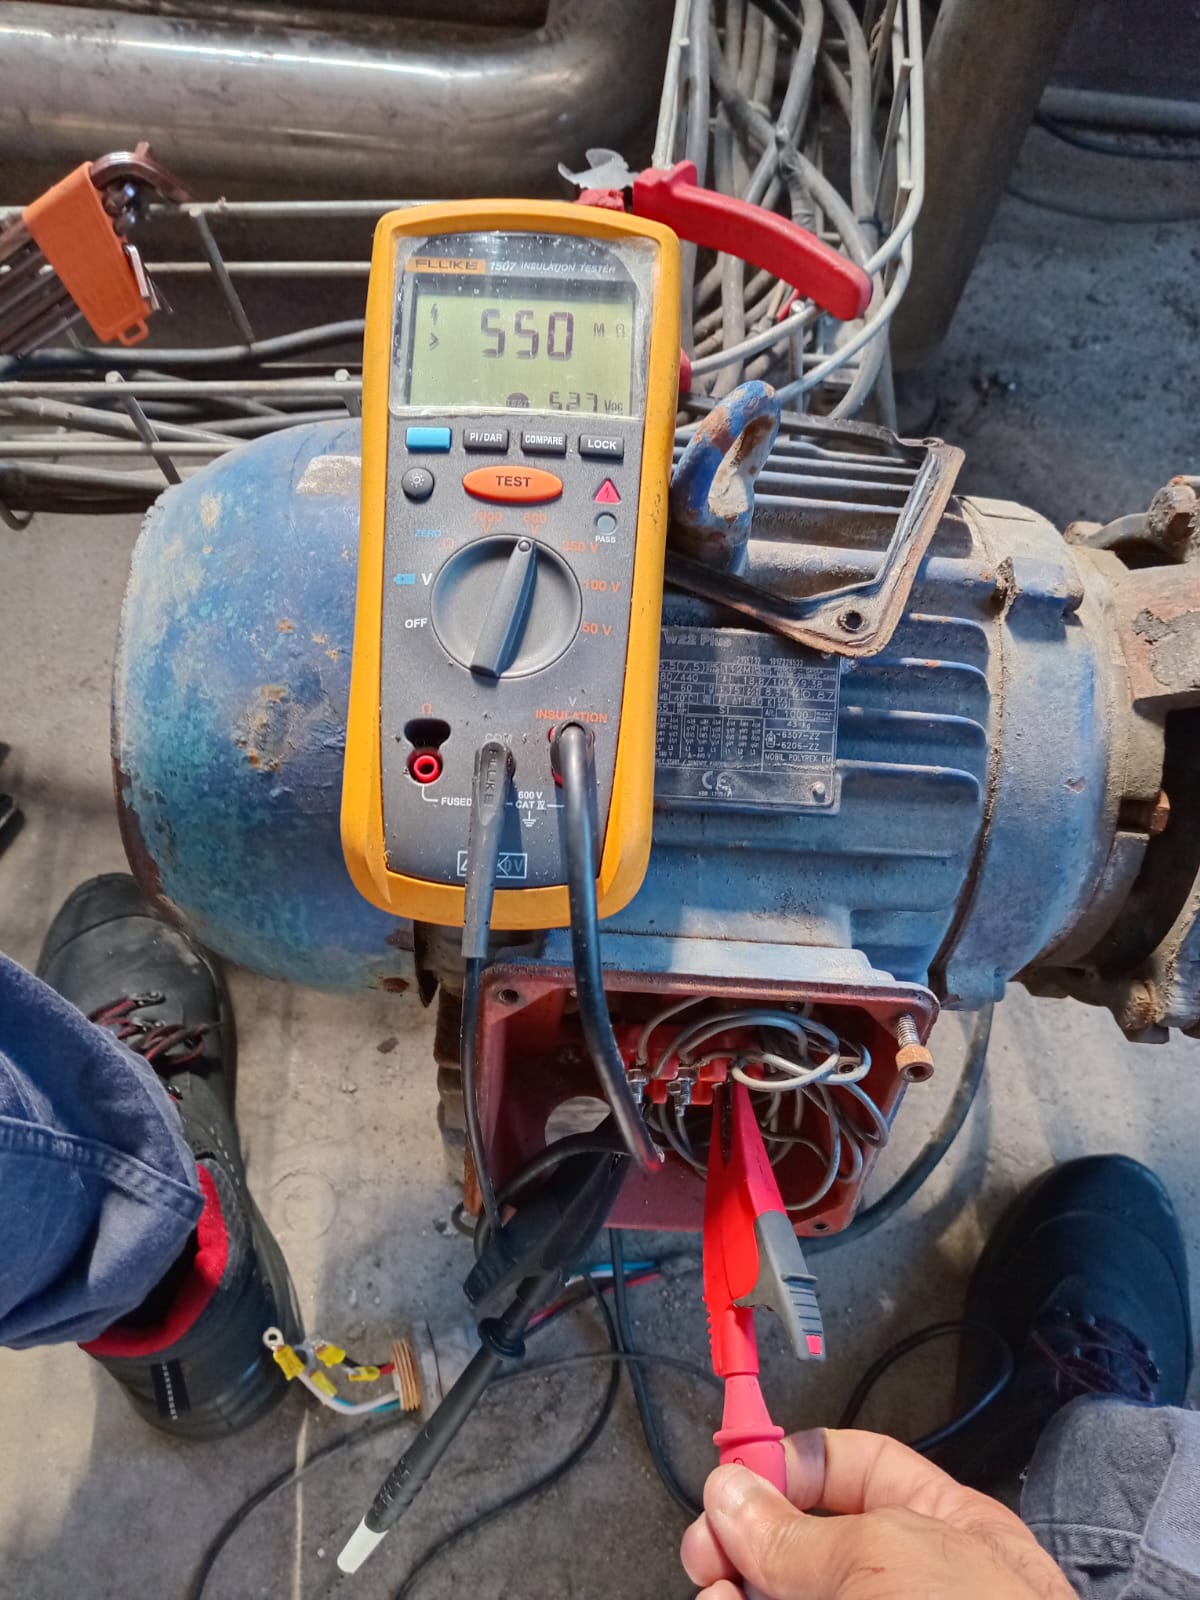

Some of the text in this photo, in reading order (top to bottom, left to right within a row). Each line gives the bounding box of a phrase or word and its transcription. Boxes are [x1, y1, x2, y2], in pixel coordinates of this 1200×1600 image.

[415, 259, 478, 271] FLUKE
[490, 261, 516, 273] 1507
[580, 263, 616, 274] TESTER
[480, 308, 574, 361] 550
[470, 432, 503, 443] PI/DAR
[525, 435, 564, 446] COMPARE
[587, 439, 617, 450] LOCK
[495, 475, 532, 488] TEST
[415, 528, 442, 538] ZERO
[595, 535, 617, 544] PASS
[421, 574, 433, 585] V
[610, 582, 621, 593] V
[404, 618, 428, 629] OFF
[582, 622, 612, 636] 50 V
[680, 684, 693, 693] 60
[802, 690, 834, 699] 0.87
[568, 696, 577, 705] V
[535, 709, 608, 723] INSULATION
[518, 791, 535, 800] 600
[441, 796, 473, 807] FUSED
[515, 800, 534, 809] CAT
